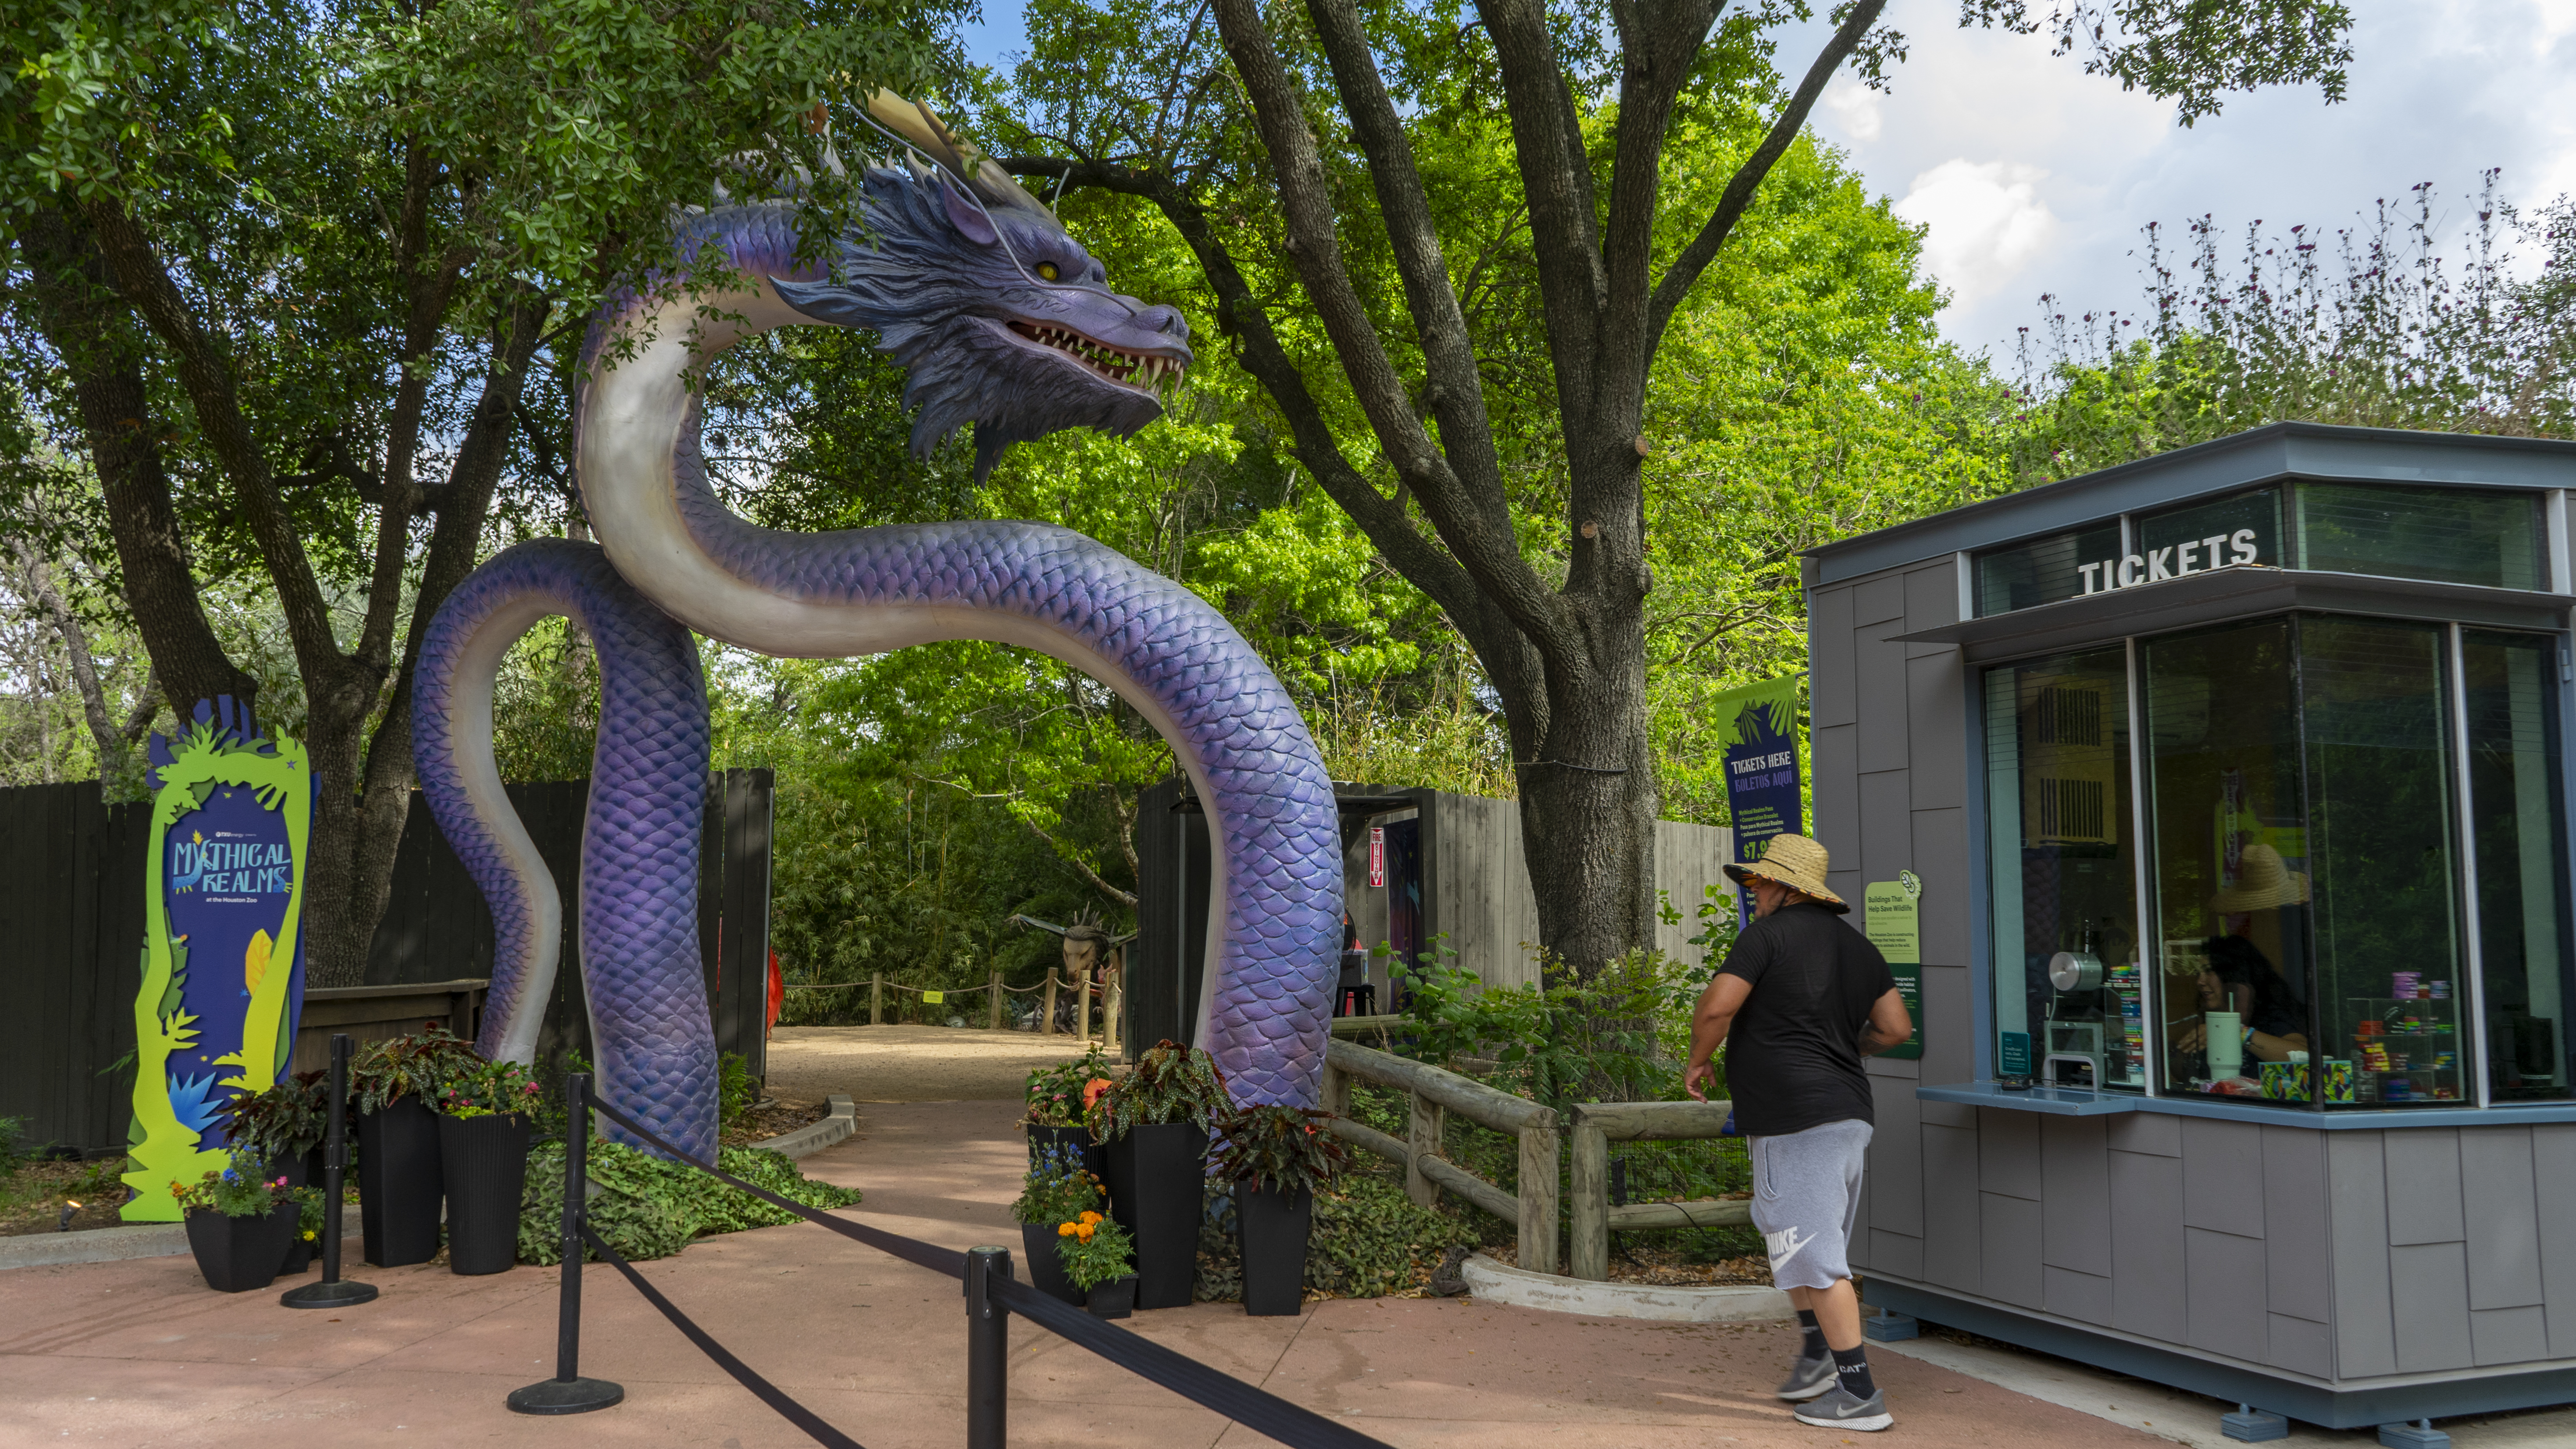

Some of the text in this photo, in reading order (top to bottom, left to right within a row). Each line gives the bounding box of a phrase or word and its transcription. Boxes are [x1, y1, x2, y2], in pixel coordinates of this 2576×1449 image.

[2078, 529, 2258, 595] TICKETS
[1731, 751, 1791, 774] TICKETS HERE
[1734, 766, 1792, 792] BOLETOS AQUÍ
[173, 839, 291, 890] MYTHICAL
[203, 866, 287, 893] REALMS
[1766, 1225, 1798, 1255] NIKE
[1839, 1364, 1861, 1373] CAT
